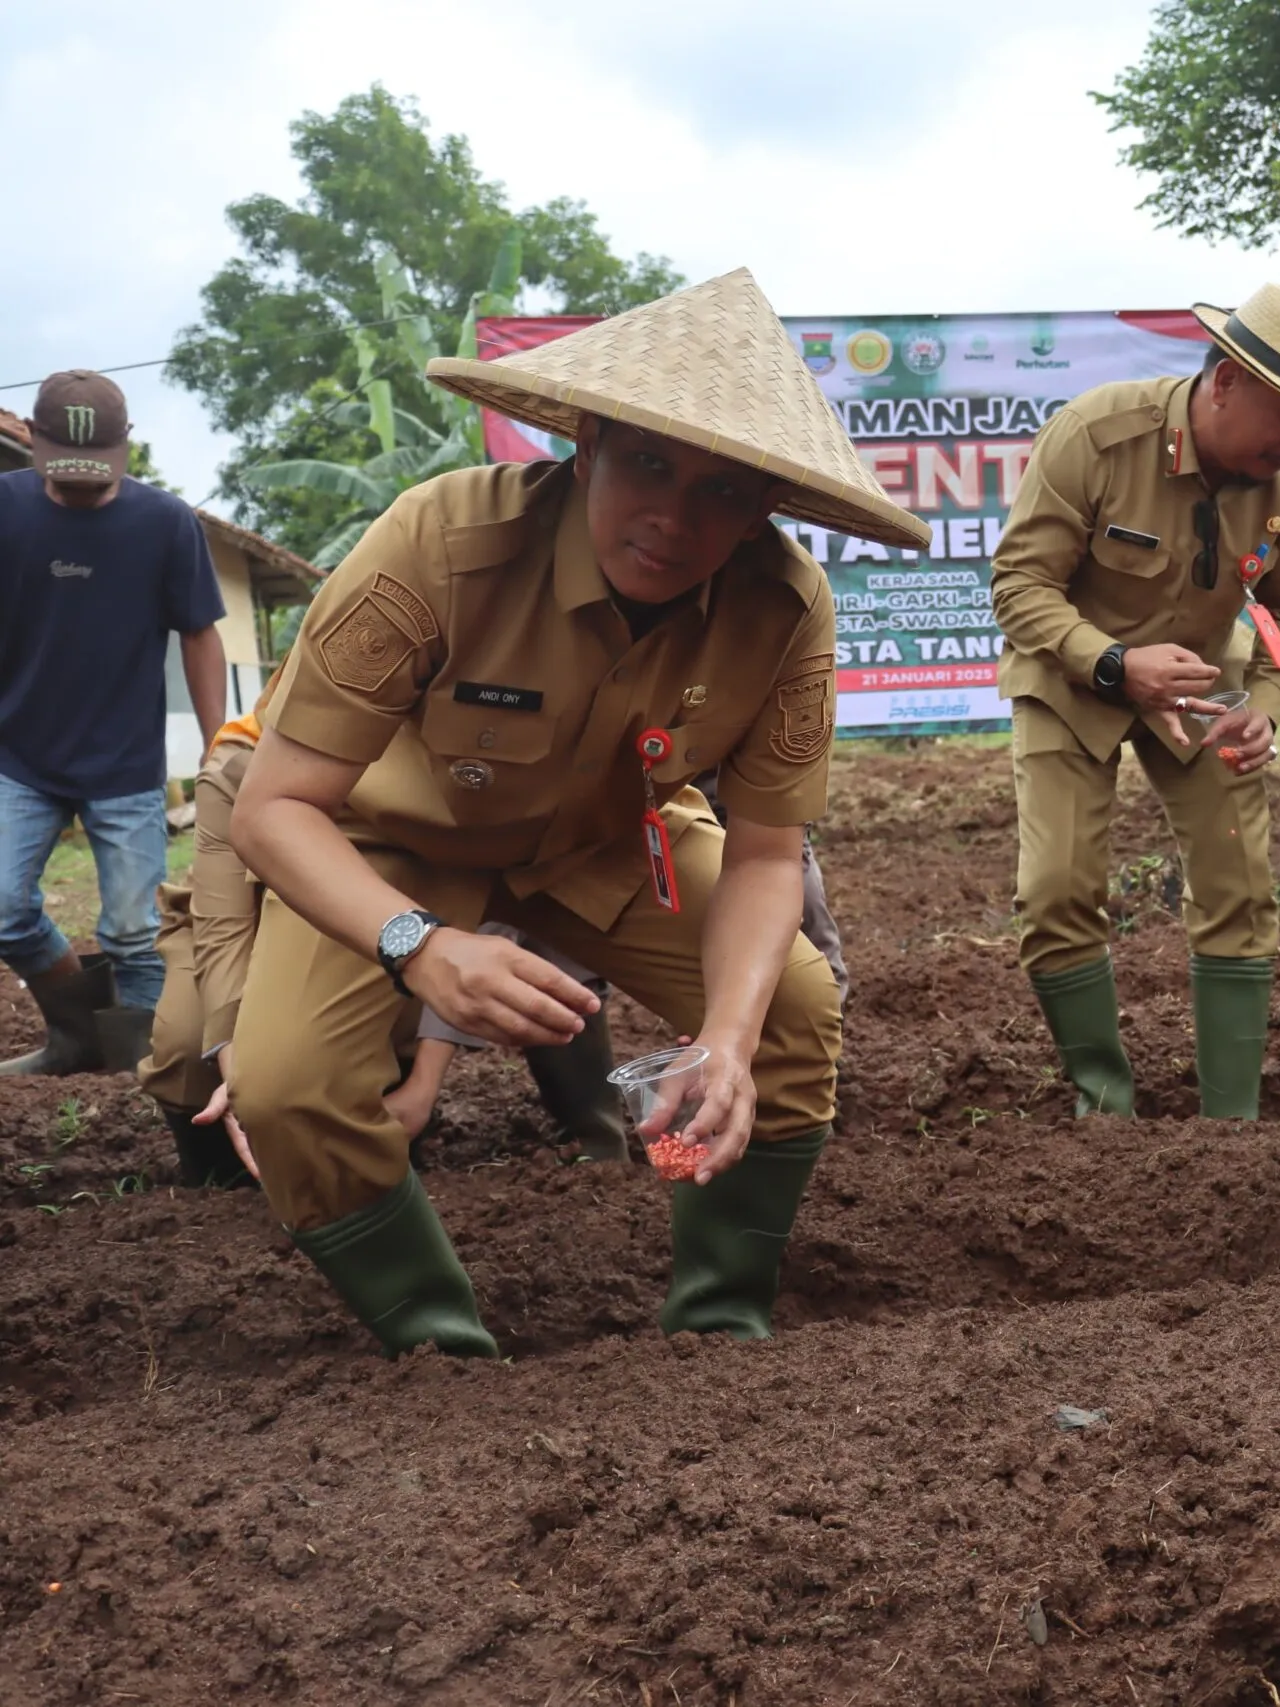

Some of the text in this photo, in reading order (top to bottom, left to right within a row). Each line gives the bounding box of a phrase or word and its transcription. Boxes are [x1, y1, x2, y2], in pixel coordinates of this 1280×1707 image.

[1015, 359, 1071, 370] Perhutani
[834, 399, 970, 437] MAN
[862, 669, 993, 685] 21 JANUARI 2025
[479, 690, 520, 704] ANDI ONY
